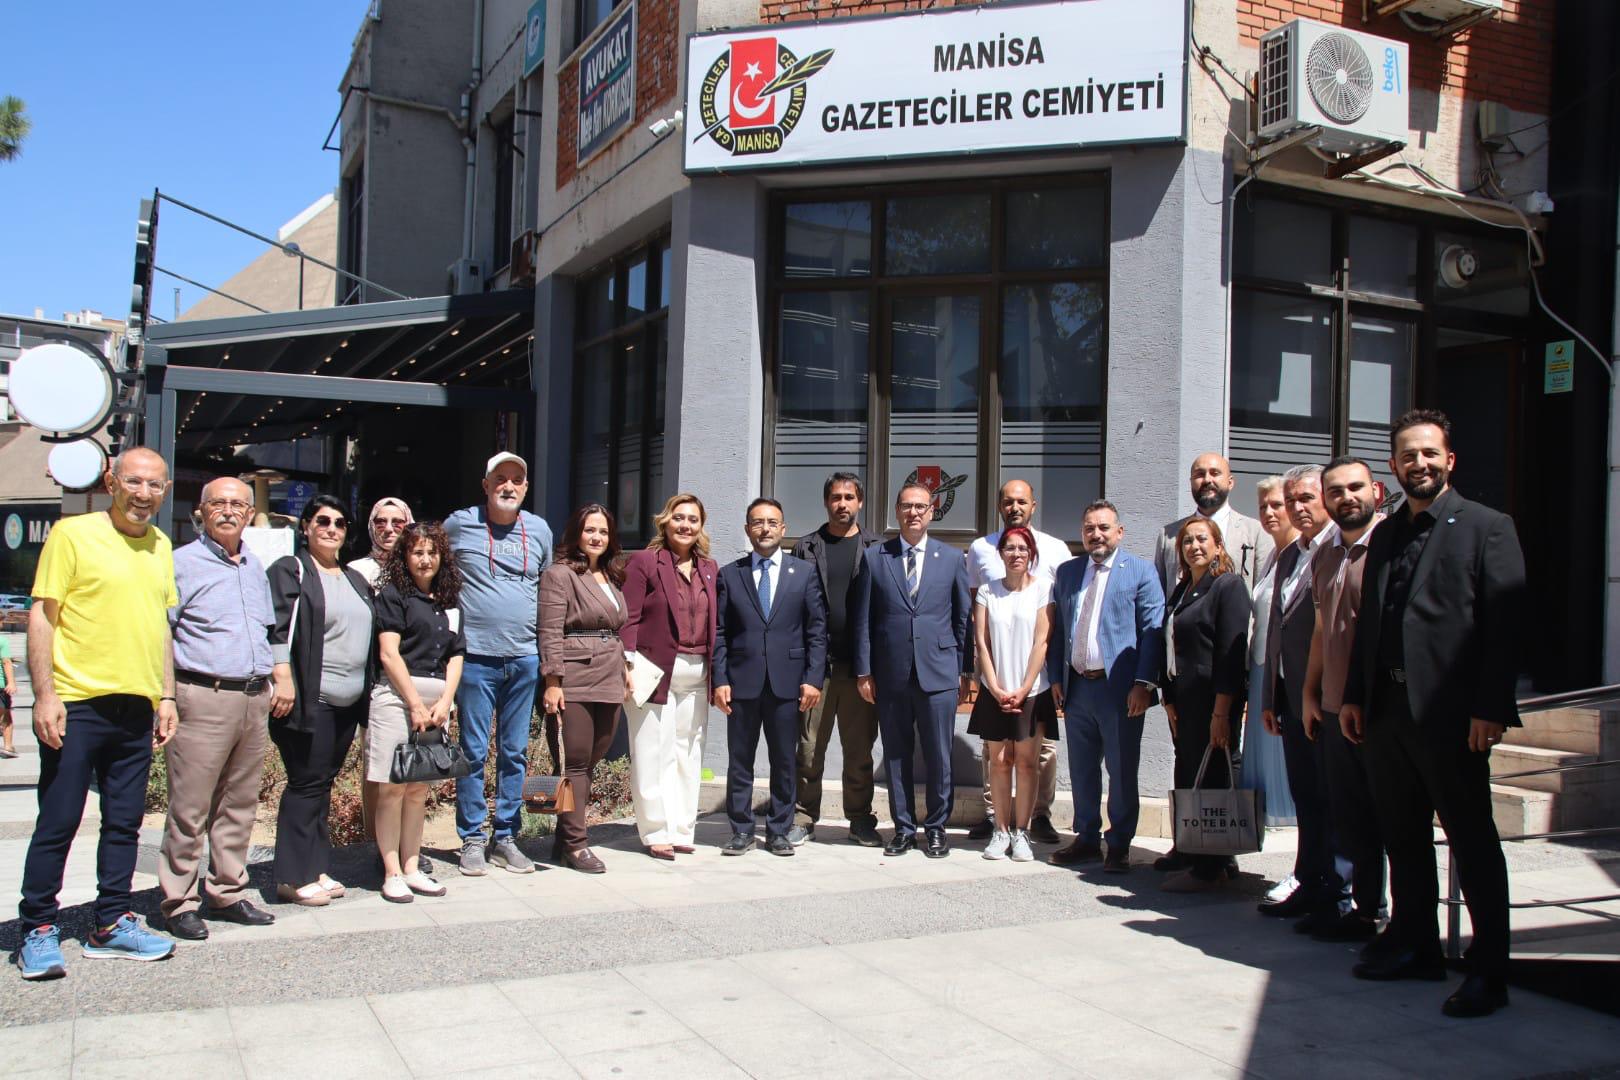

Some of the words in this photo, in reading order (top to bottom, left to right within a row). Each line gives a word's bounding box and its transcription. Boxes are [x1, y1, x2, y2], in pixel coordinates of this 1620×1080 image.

[585, 24, 629, 95] AVUKAT
[933, 32, 1044, 73] MANİSA
[1383, 47, 1393, 92] beko
[821, 88, 1013, 132] GAZETECİLER
[1022, 72, 1164, 118] CEMİYETİ
[737, 130, 780, 152] MANİSA
[1202, 808, 1227, 817] THE
[1220, 819, 1248, 828] BAG
